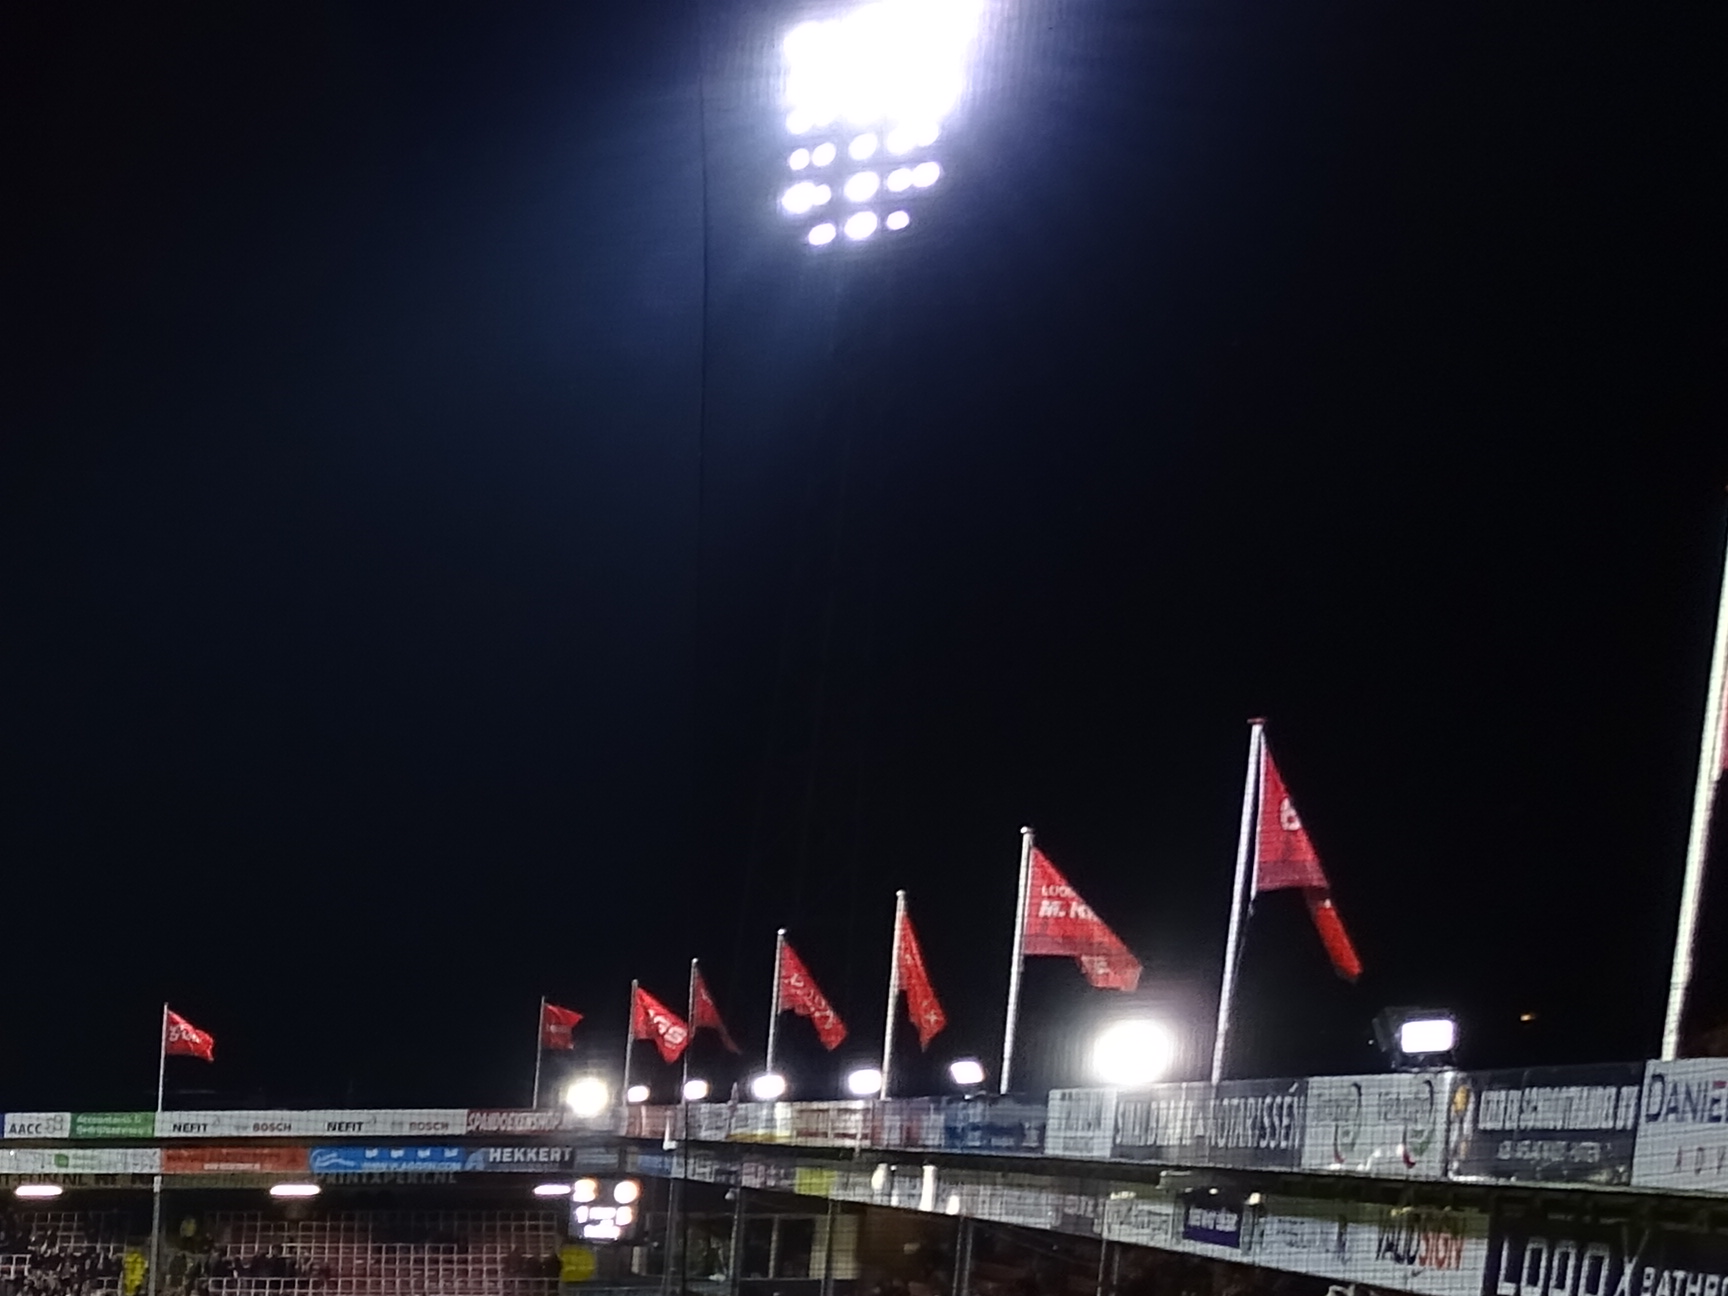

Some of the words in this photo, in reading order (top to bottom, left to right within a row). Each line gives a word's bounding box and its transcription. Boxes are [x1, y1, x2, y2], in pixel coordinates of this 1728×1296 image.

[172, 1122, 209, 1133] NEFIT
[252, 1121, 292, 1133] BOSCH
[326, 1121, 364, 1133] NEFIT
[409, 1120, 449, 1132] BOSCH
[488, 1146, 574, 1164] HEKKERT
